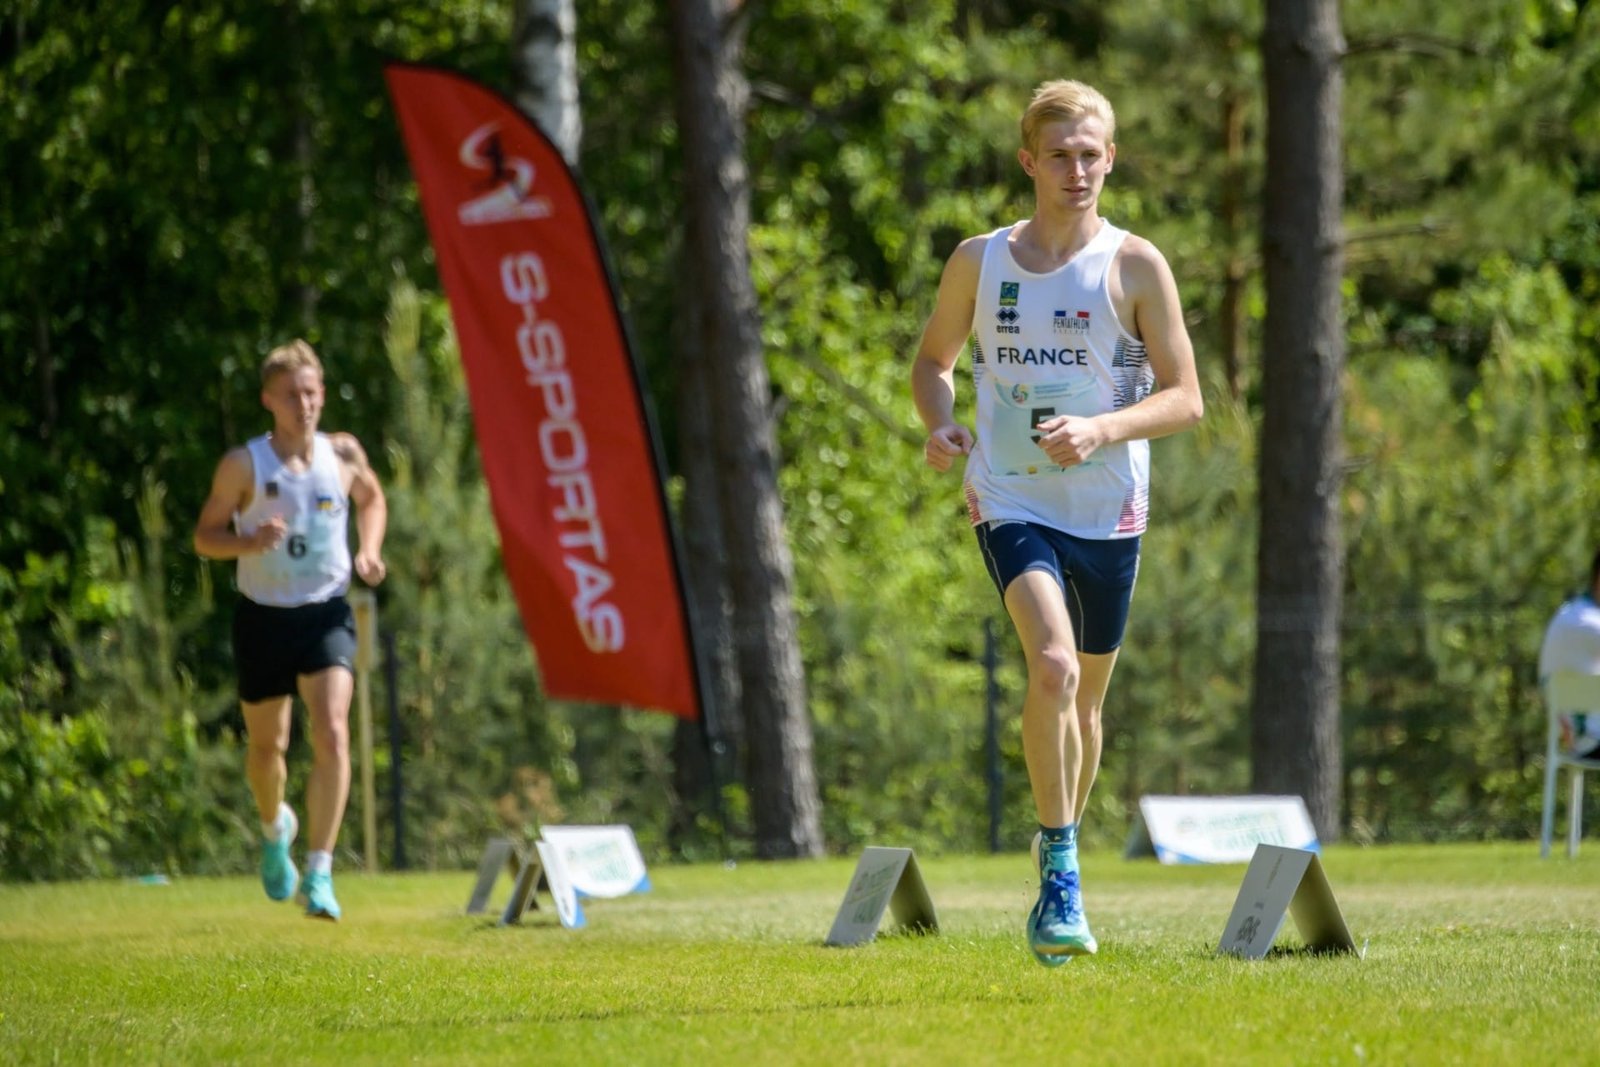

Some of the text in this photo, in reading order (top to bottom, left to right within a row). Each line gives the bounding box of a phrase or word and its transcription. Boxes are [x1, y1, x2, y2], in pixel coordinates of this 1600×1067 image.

[1053, 318, 1090, 330] PENTATHLON
[997, 347, 1088, 366] FRANCE
[501, 252, 624, 653] S-SPORTAS
[287, 535, 306, 560] 6
